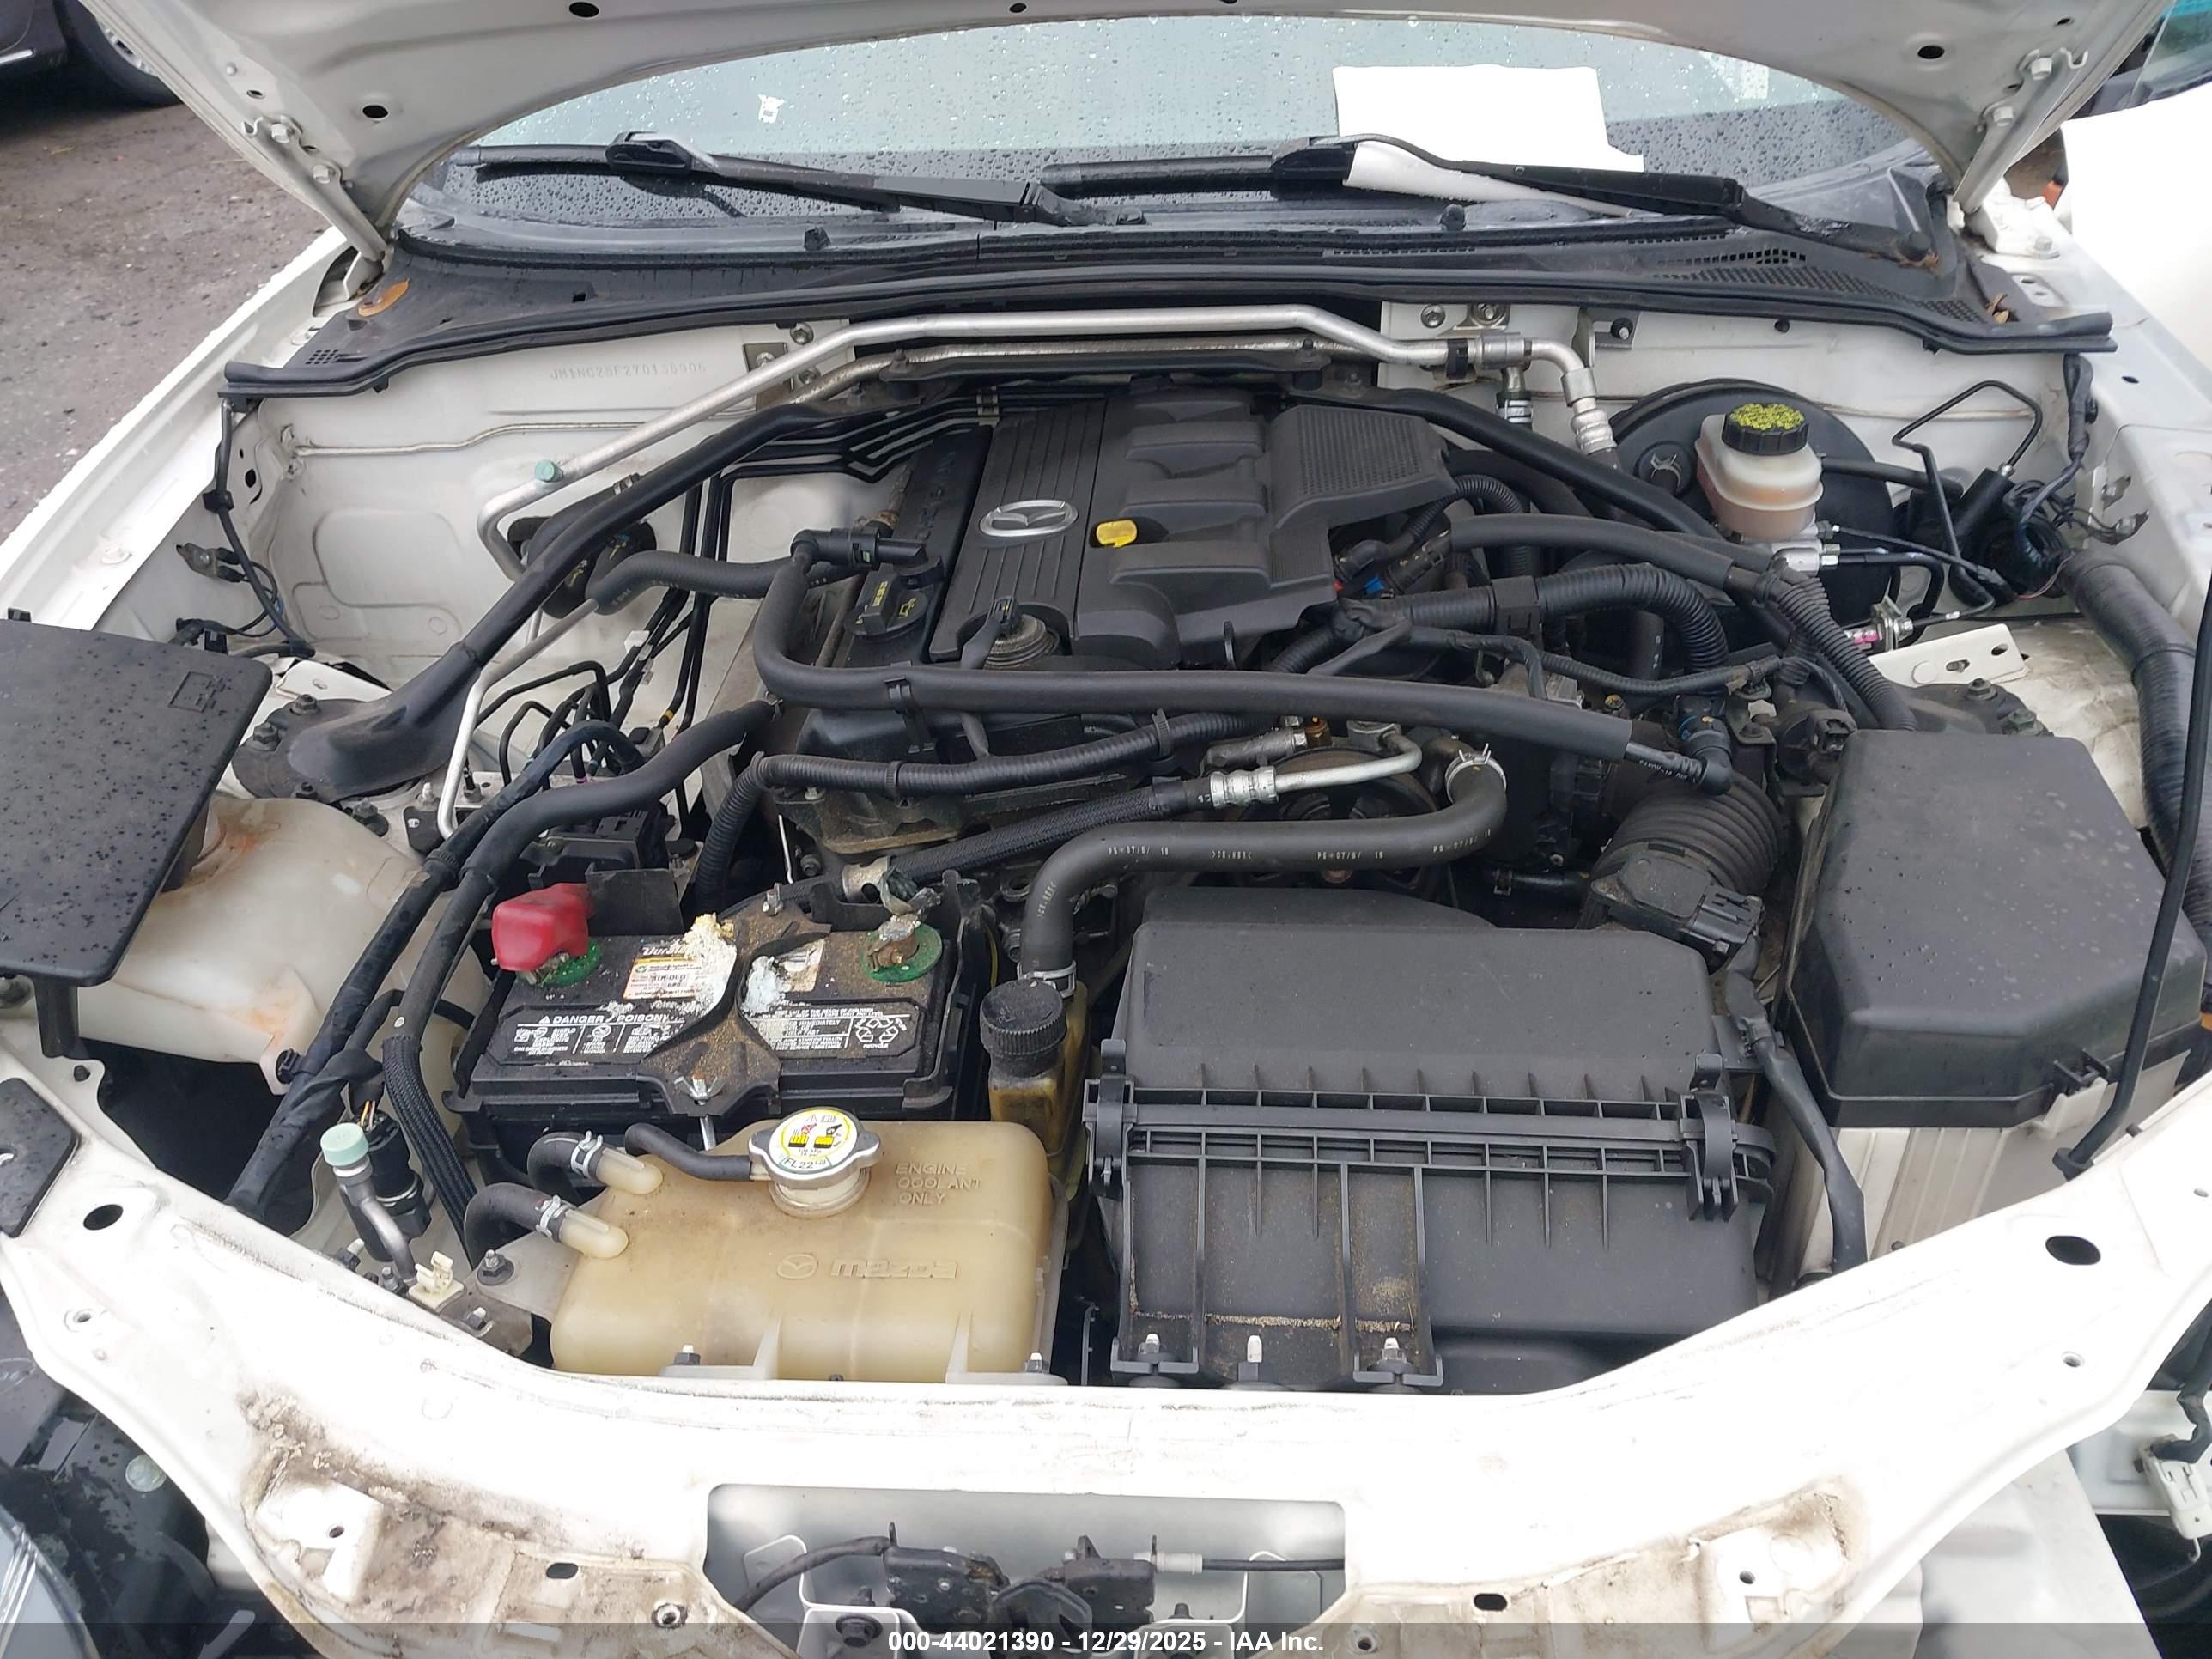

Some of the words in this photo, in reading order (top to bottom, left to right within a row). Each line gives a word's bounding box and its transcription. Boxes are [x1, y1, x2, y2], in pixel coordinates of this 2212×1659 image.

[552, 1015, 605, 1024] DANGER
[896, 1161, 967, 1176] ENGINE
[899, 1190, 946, 1205] ONLY
